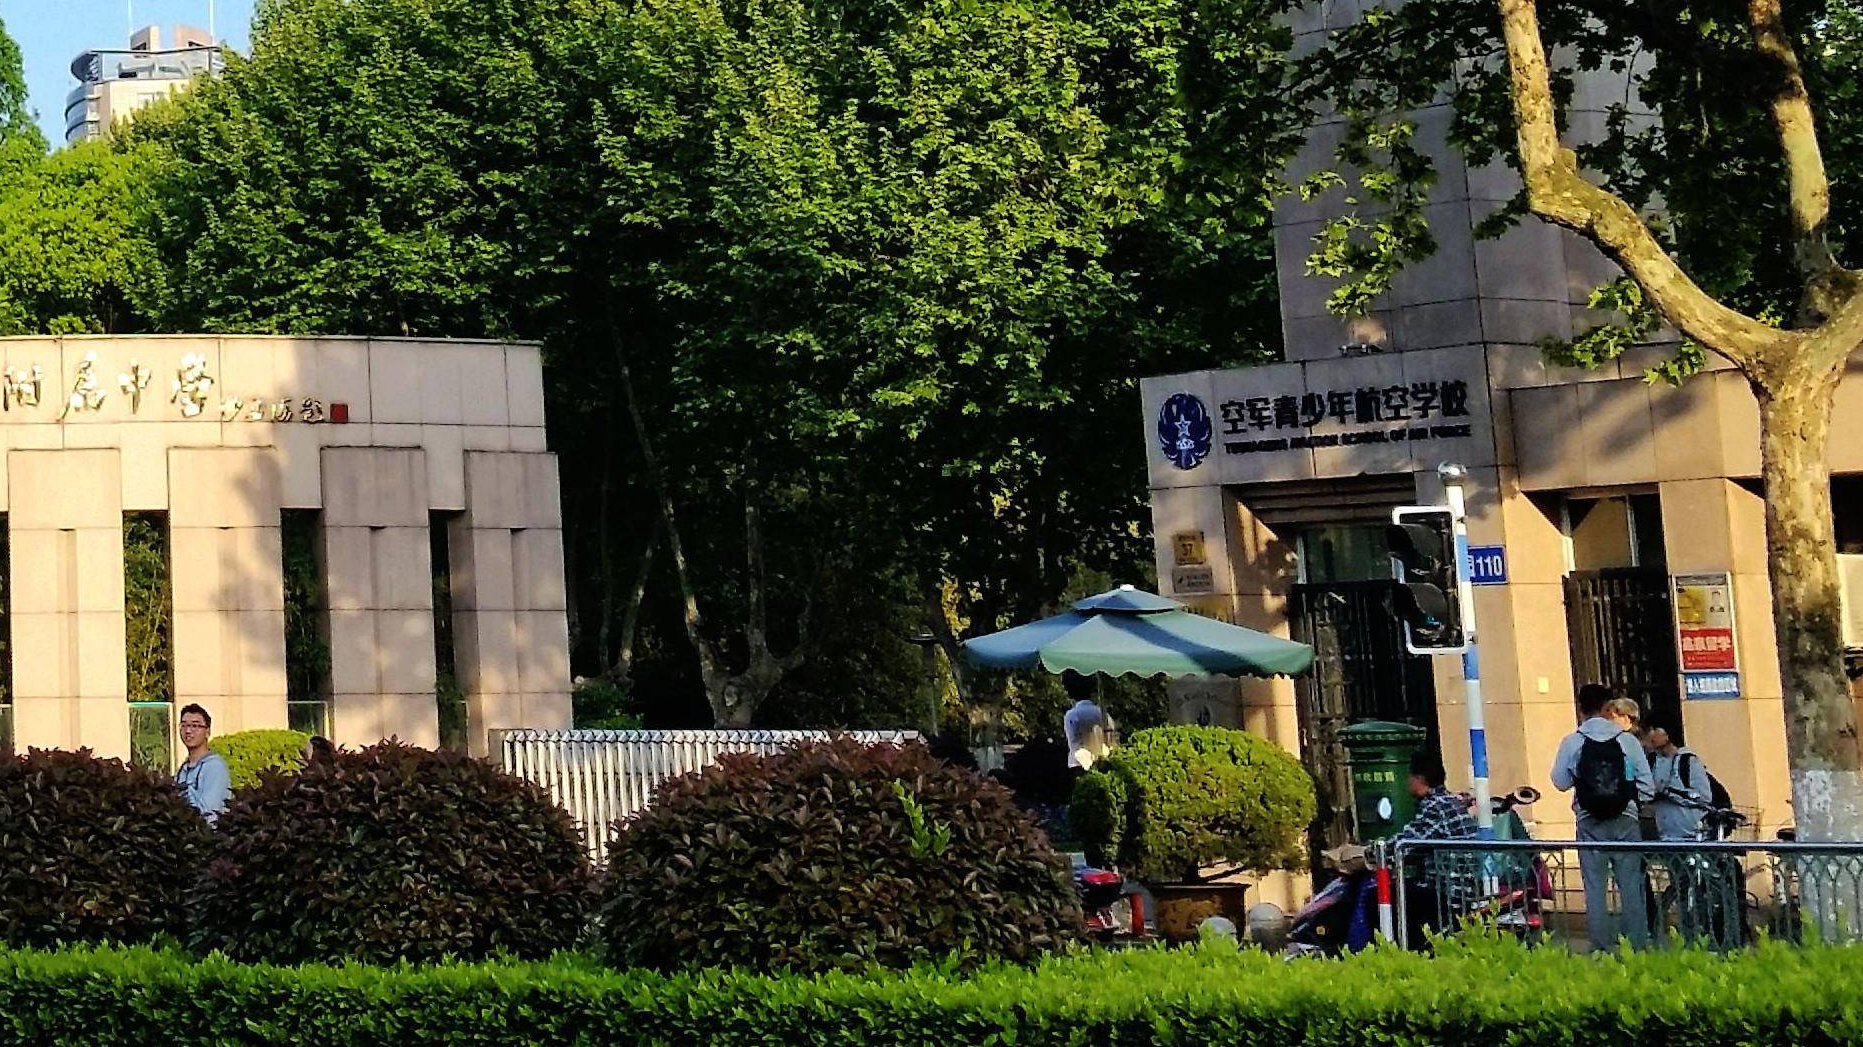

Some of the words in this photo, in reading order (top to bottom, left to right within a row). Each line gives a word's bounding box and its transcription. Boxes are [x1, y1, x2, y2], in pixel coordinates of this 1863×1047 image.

[1220, 380, 1470, 435] 空军青少年航空学校
